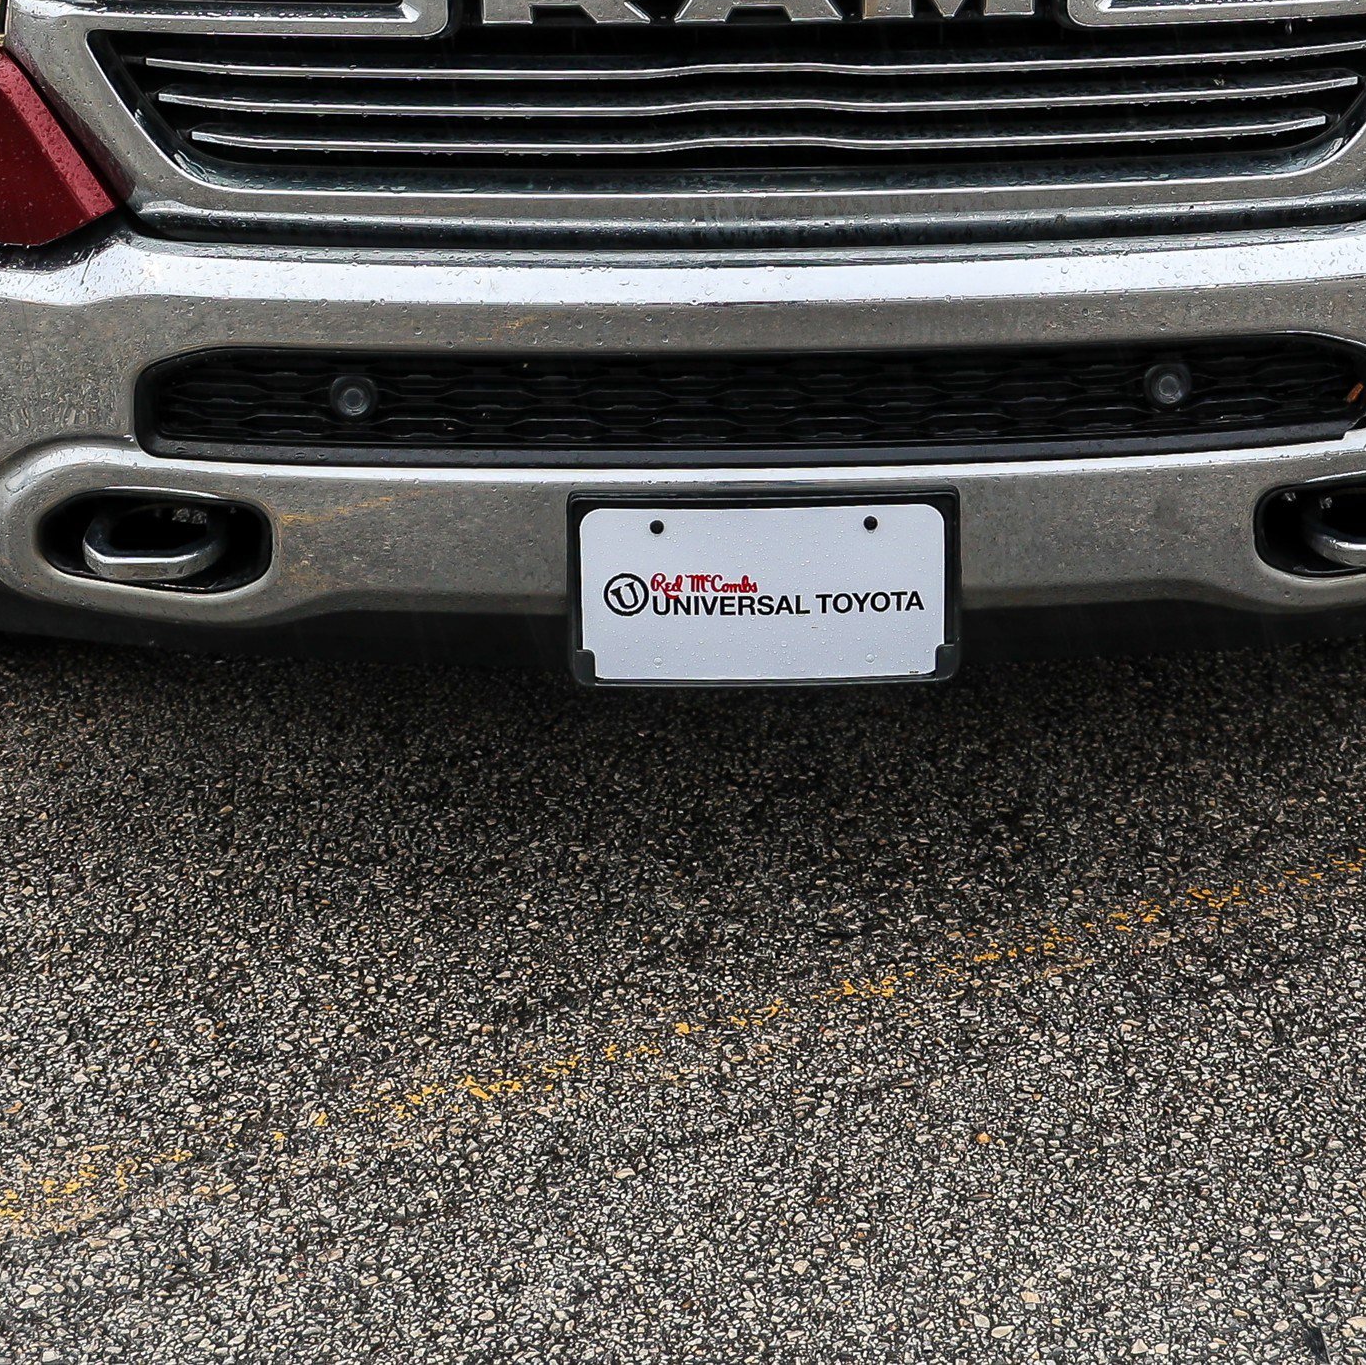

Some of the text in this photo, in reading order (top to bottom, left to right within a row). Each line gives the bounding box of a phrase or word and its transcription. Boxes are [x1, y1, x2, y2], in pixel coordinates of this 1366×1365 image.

[650, 572, 683, 600] Red
[652, 590, 925, 616] UNIVERSAL TOYOTA
